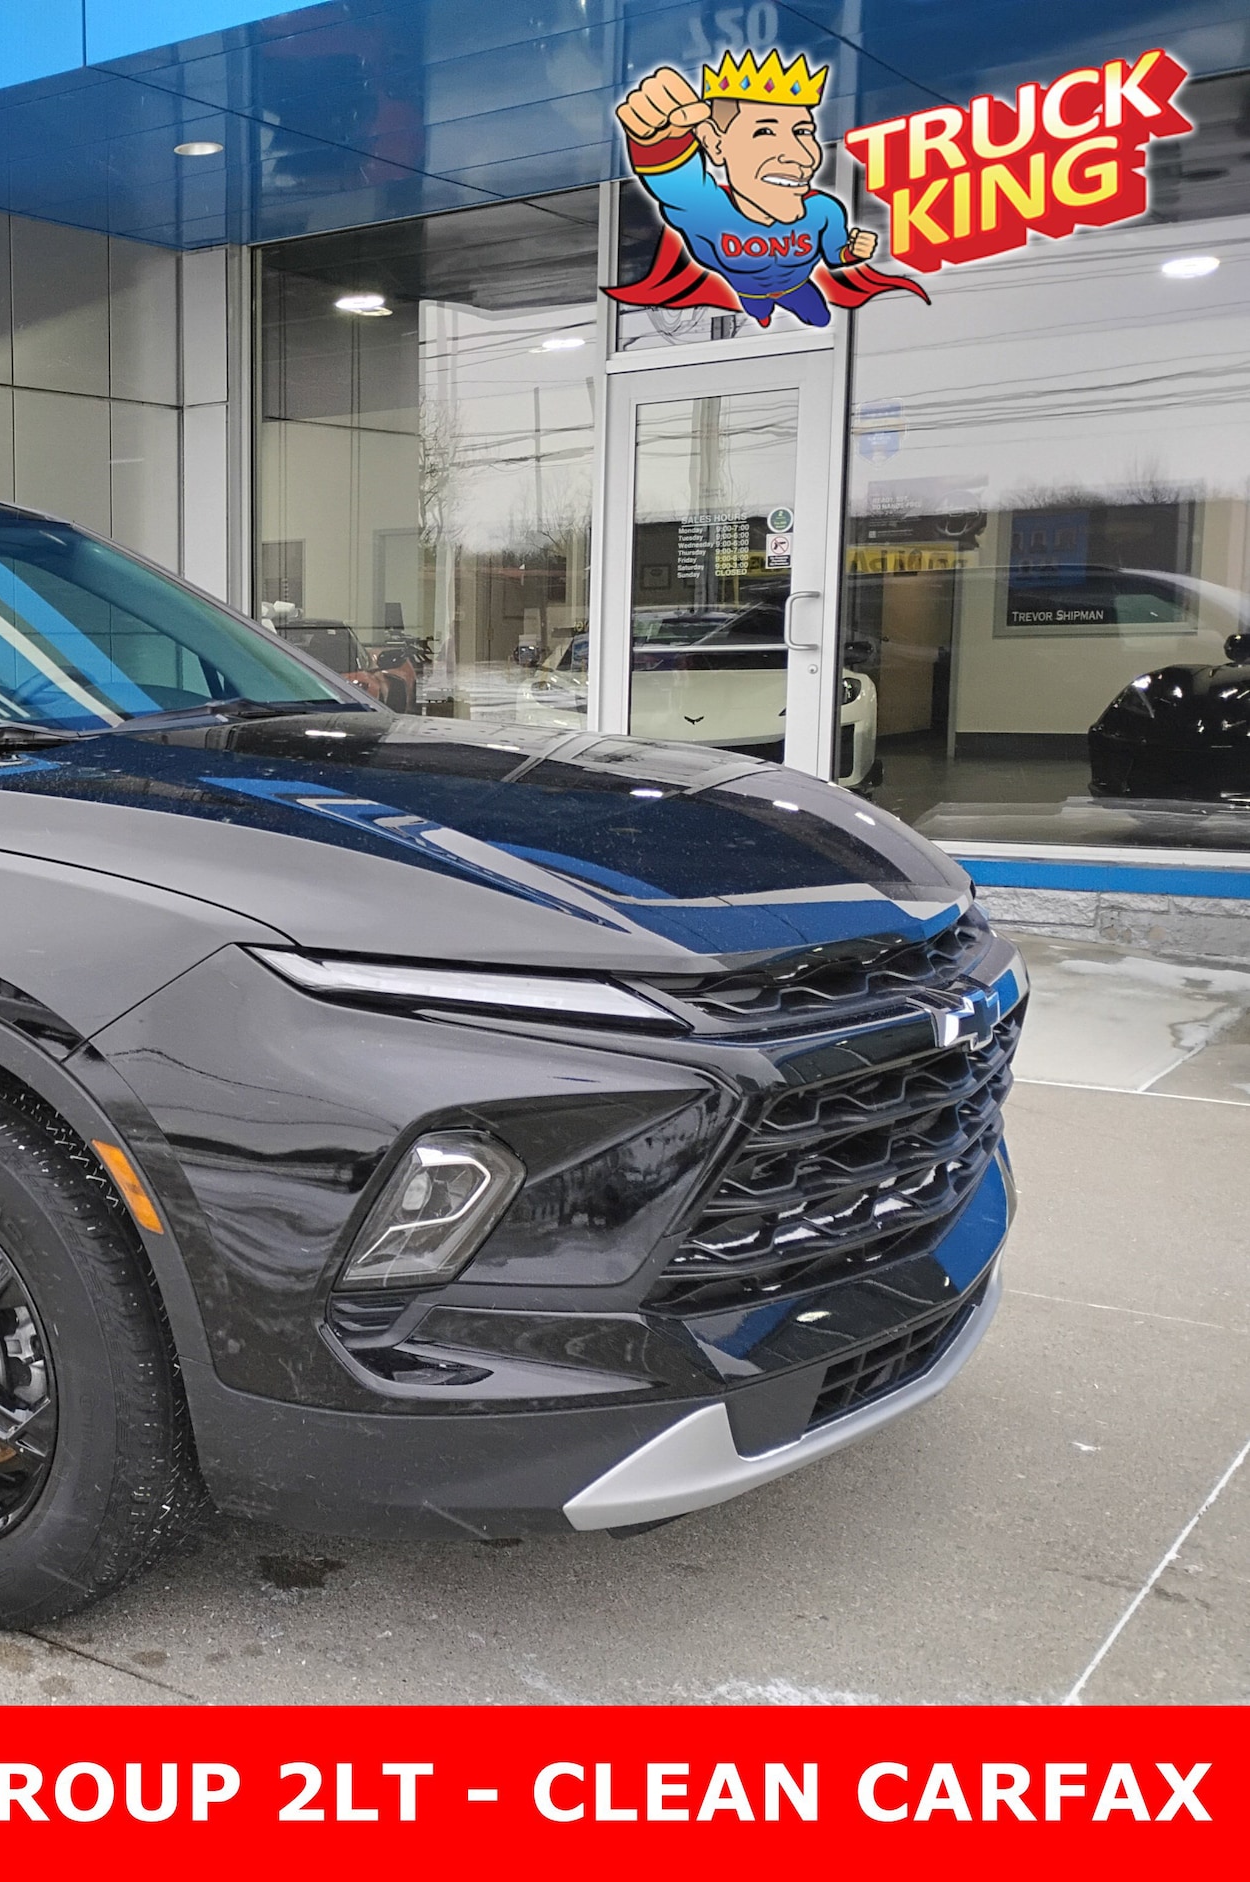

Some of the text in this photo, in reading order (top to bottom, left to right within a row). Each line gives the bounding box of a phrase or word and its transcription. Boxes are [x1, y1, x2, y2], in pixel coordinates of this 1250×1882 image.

[681, 512, 747, 525] SALES HOURS
[678, 541, 715, 549] Wednesday
[678, 549, 706, 557] Thursday
[677, 556, 697, 564] Friday
[677, 571, 700, 579] Sunday
